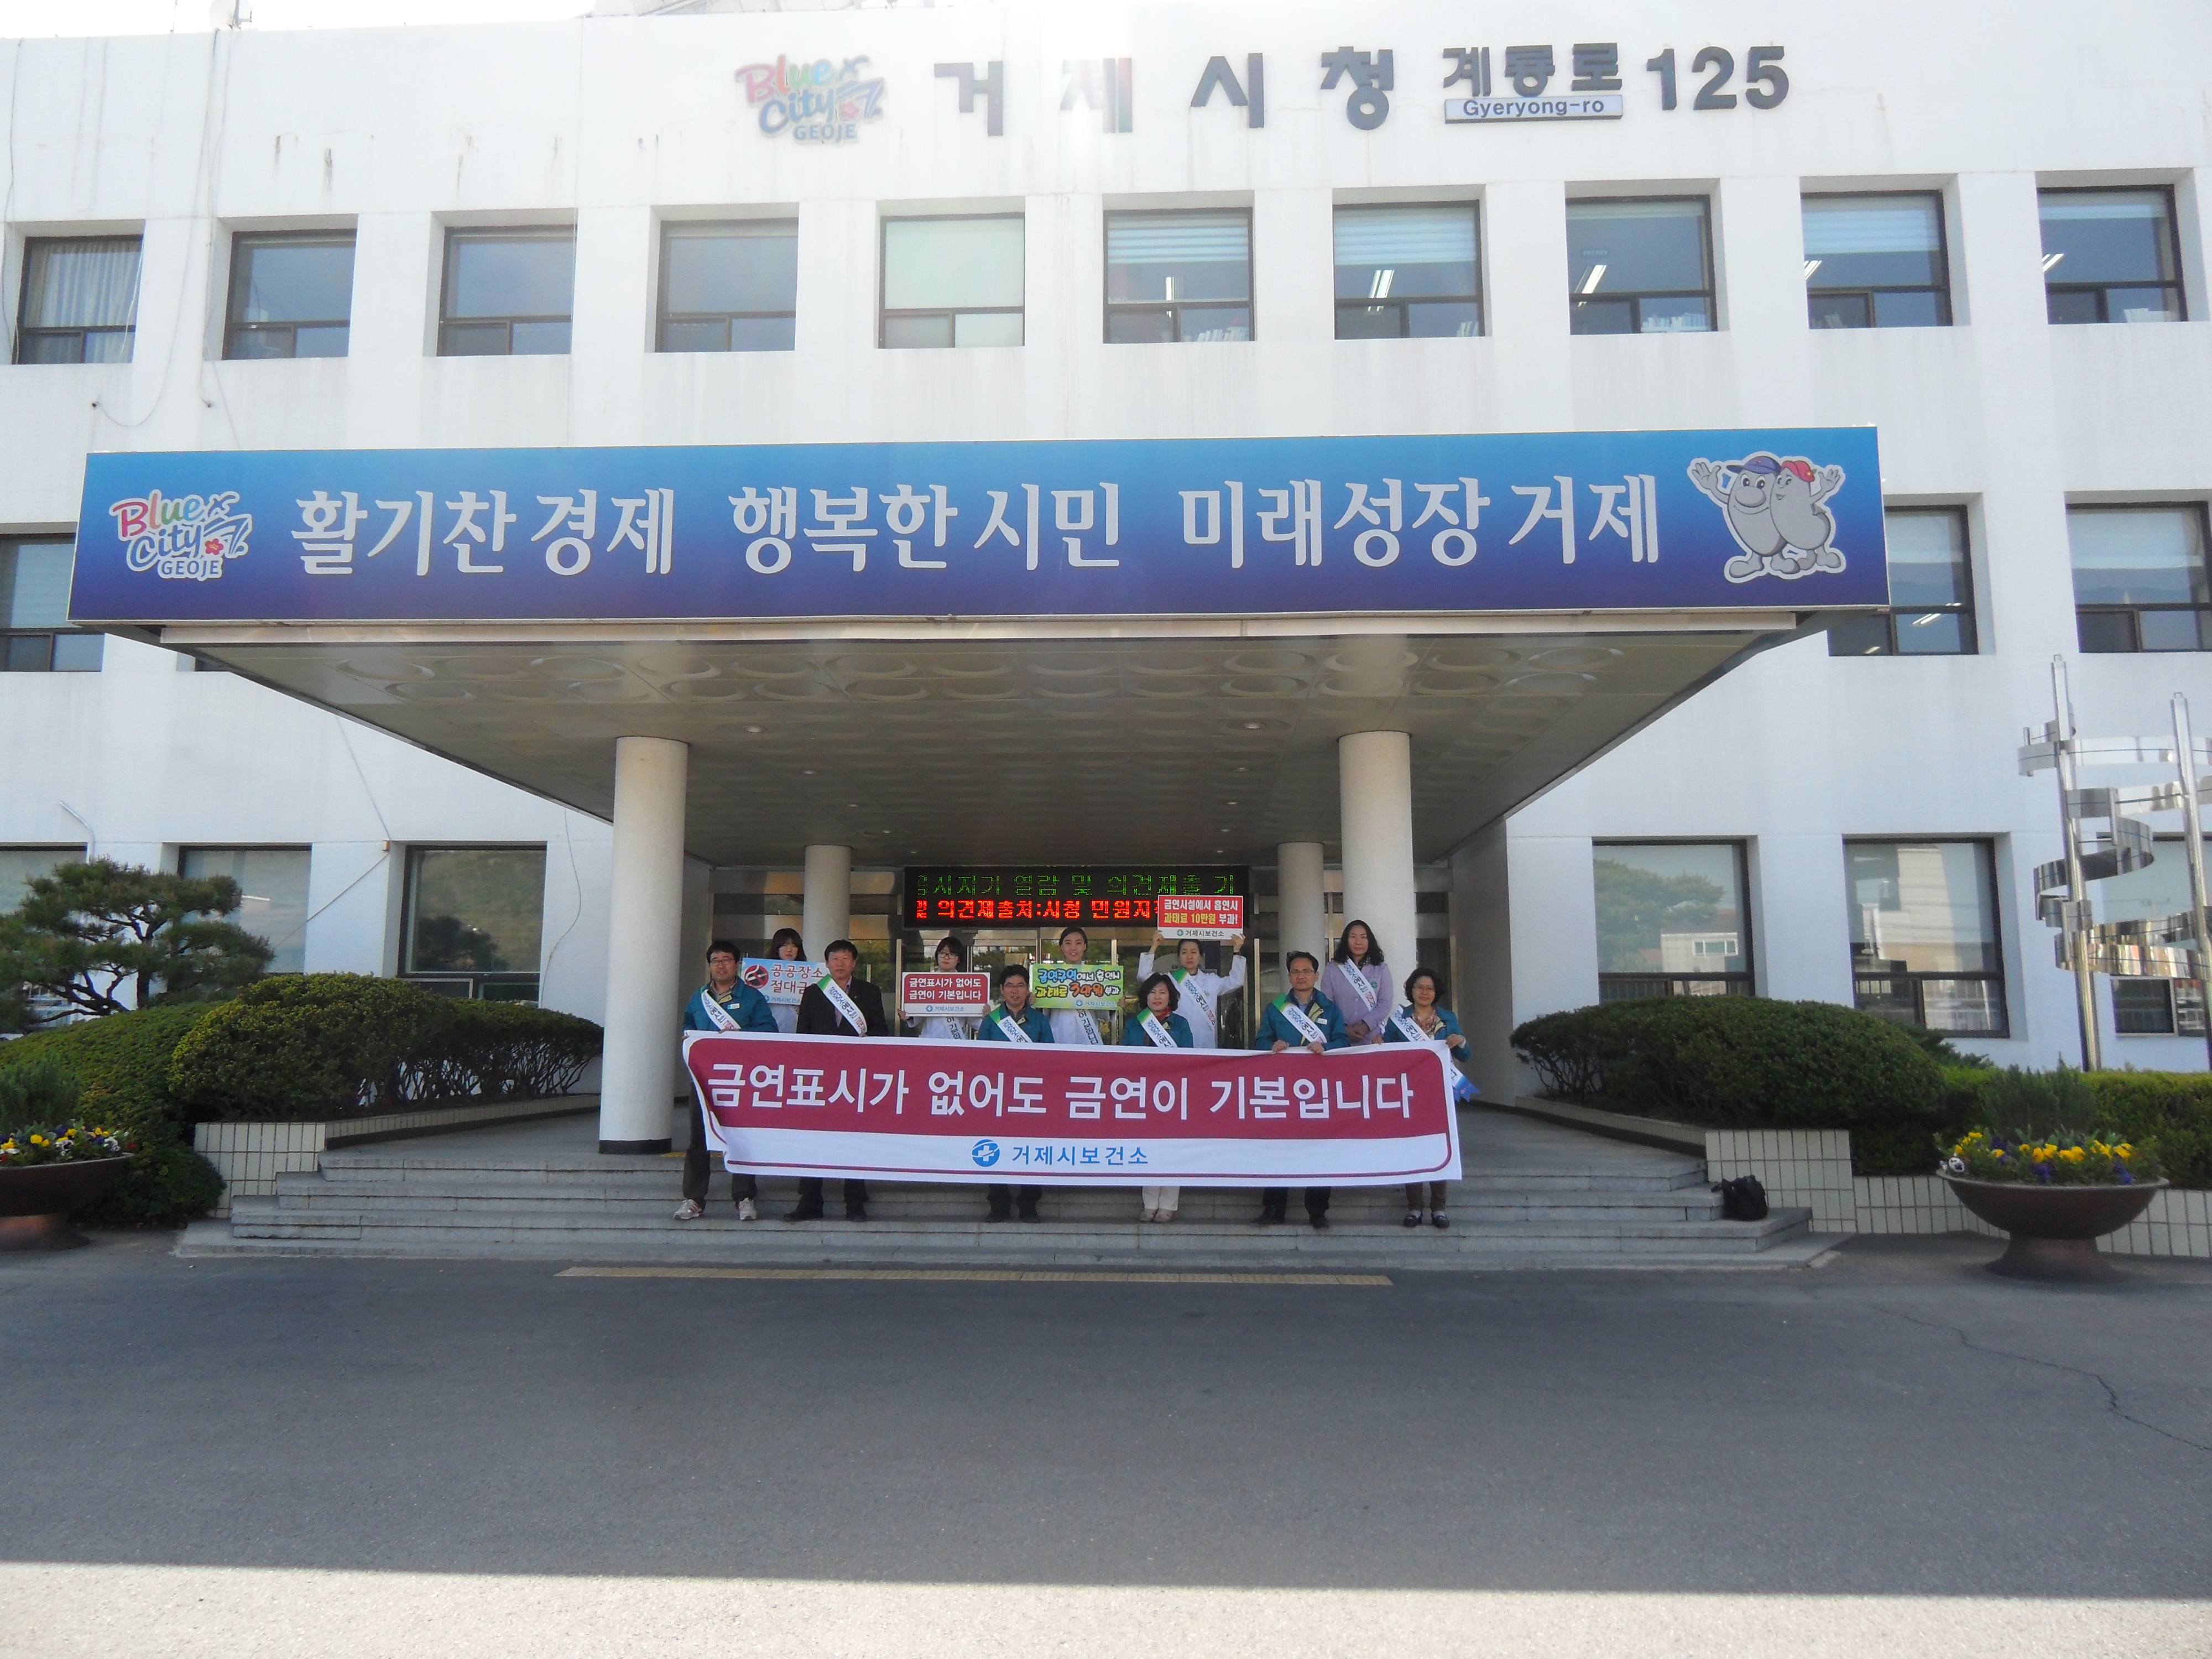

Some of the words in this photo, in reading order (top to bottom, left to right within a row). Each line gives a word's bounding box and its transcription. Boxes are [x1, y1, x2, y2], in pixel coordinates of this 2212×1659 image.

[735, 54, 836, 103] Blue
[1443, 43, 1622, 96] 계룡로
[1646, 45, 1790, 111] 125
[759, 87, 838, 136] City
[1462, 98, 1605, 118] Gyeryong-ro
[793, 123, 857, 142] GEOJE
[109, 489, 203, 539] Blue
[128, 525, 204, 572] City
[160, 559, 220, 580] GEOJE
[1014, 875, 1060, 895] 열람
[1071, 875, 1092, 895] 및
[1164, 899, 1211, 910] 금연시설에서
[1214, 900, 1238, 911] 흡연시
[1164, 912, 1188, 924] 과태료
[1191, 913, 1216, 925] 10만원
[1219, 914, 1238, 925] 부과!
[770, 963, 825, 979] 공공장소
[1037, 968, 1094, 983] 금연구역에서
[909, 978, 952, 988] 금연표시가
[956, 978, 982, 988] 없어도
[1035, 985, 1068, 998] 과태료
[1069, 982, 1104, 998] 3만원
[1104, 985, 1121, 995] 부과
[909, 990, 935, 1000] 금연이
[938, 990, 981, 1000] 기본입니다
[708, 1063, 909, 1115] 금연표시가
[928, 1070, 1047, 1117] 없어도
[1065, 1076, 1187, 1120] 금연이
[1209, 1072, 1414, 1120] 기본입니다
[1011, 1145, 1149, 1166] 거제시보건소
